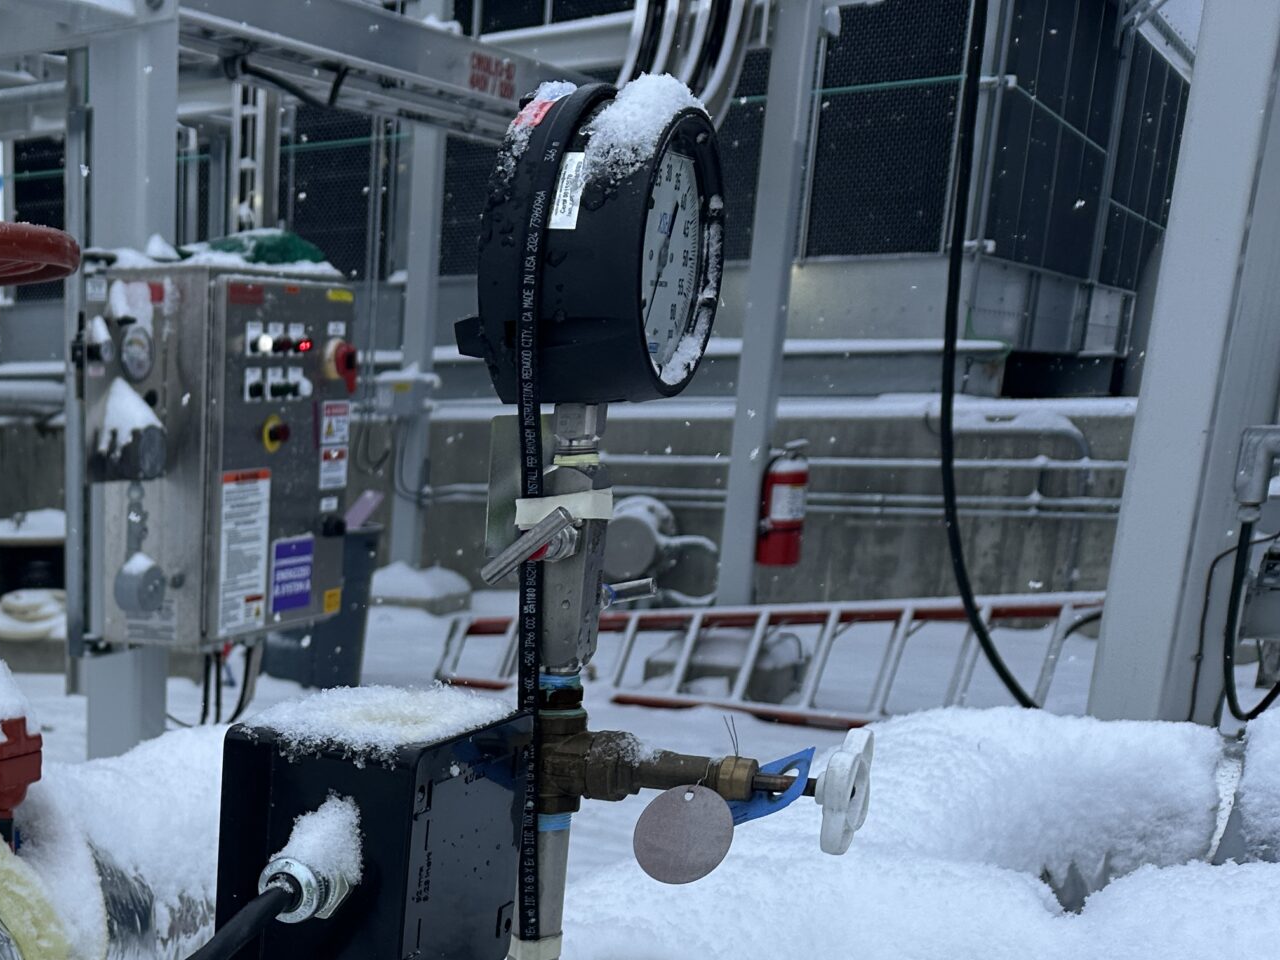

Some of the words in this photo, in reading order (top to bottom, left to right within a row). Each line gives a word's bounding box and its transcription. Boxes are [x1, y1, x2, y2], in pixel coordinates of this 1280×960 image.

[527, 232, 539, 253] 2024
[525, 256, 537, 272] USA
[524, 275, 535, 285] IN
[522, 289, 534, 308] MADE
[522, 311, 533, 322] CA
[521, 351, 532, 379] REDWOOD
[522, 382, 535, 426] INSTRUCTIONS
[527, 455, 537, 467] PER
[527, 469, 538, 495] INSTALL
